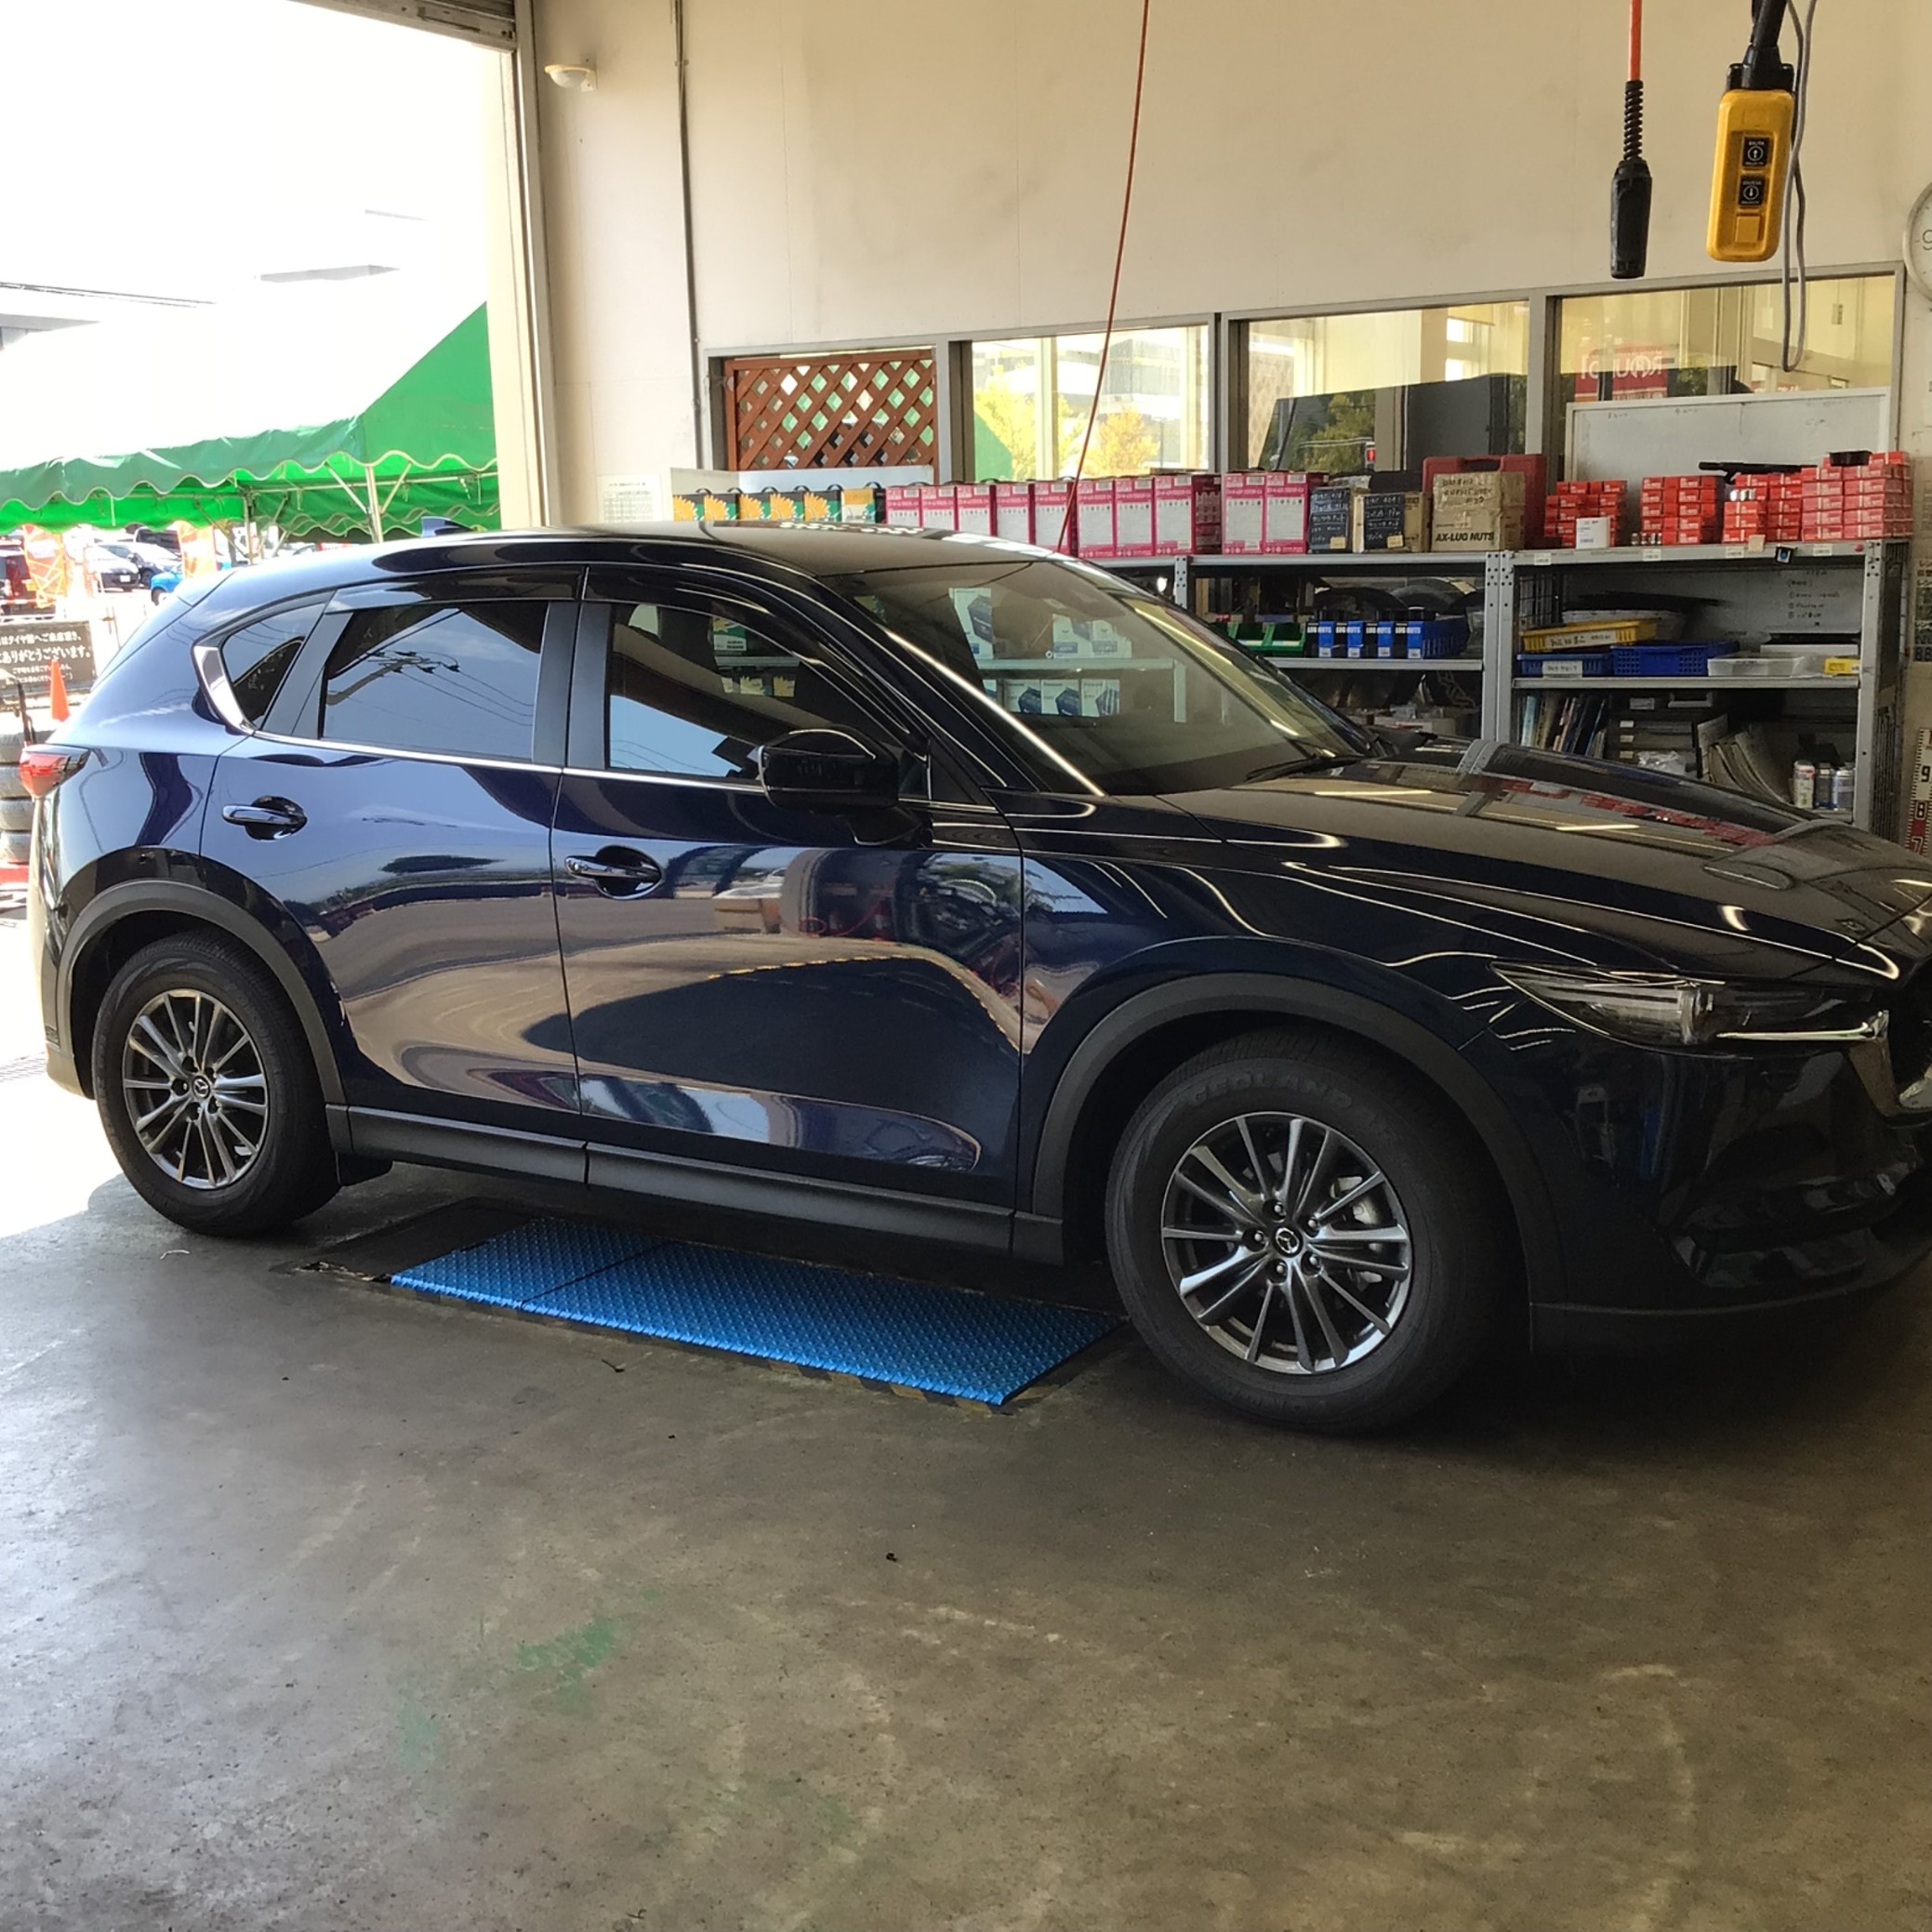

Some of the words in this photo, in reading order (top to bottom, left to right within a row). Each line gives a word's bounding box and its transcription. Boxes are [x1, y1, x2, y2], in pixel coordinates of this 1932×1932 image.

[1436, 532, 1468, 542] AX-LUG
[1470, 531, 1495, 542] NUTS
[1921, 765, 1931, 782] 9
[1915, 801, 1926, 820] 8
